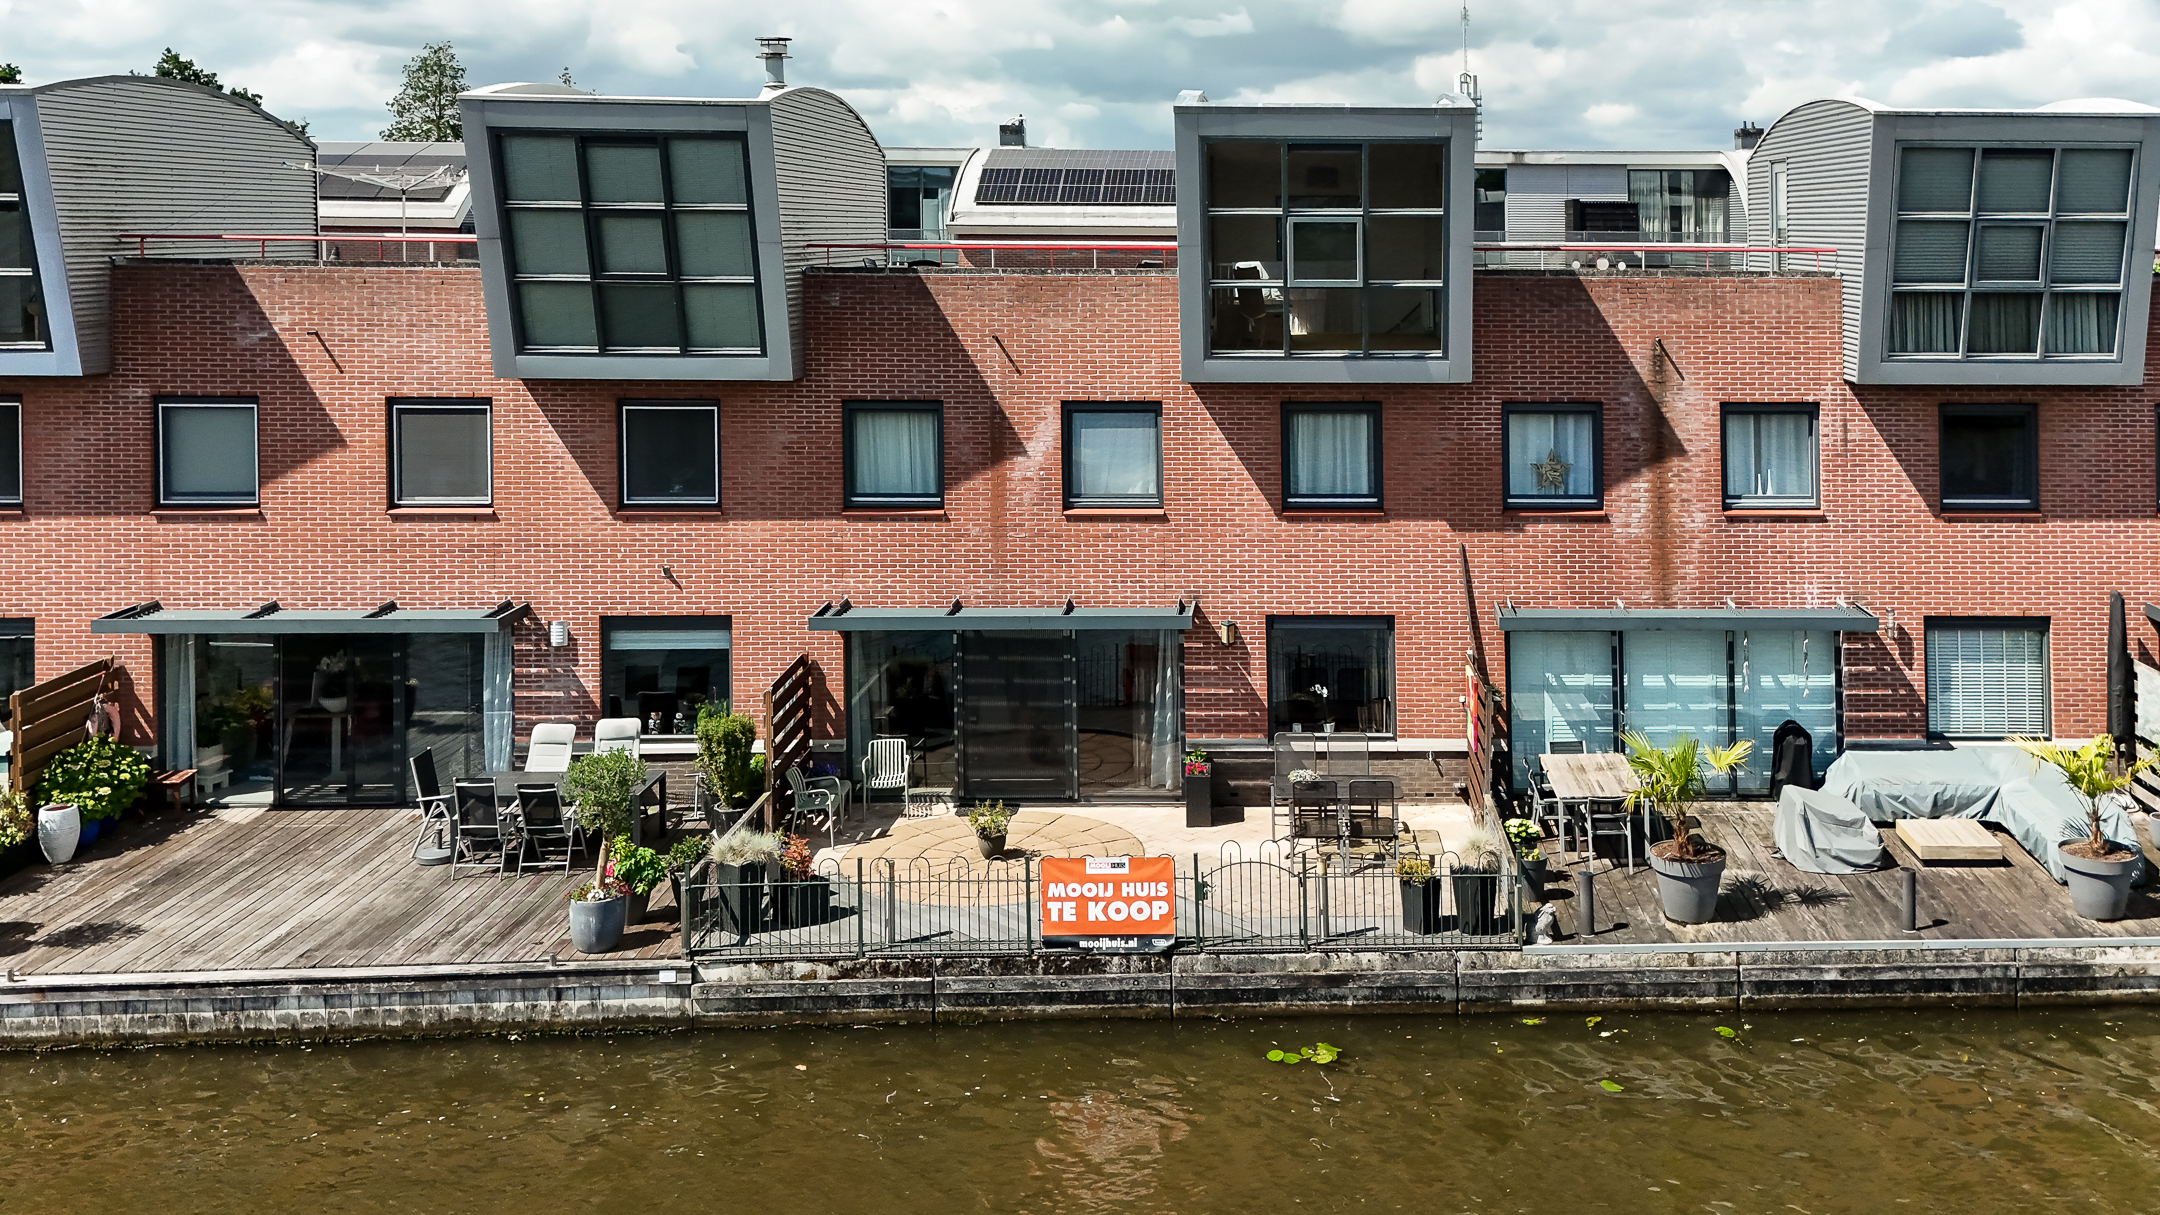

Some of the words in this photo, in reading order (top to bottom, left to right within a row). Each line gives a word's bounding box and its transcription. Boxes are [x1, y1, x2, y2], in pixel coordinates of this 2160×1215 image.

[1047, 882, 1114, 898] MOOIJ
[1121, 881, 1169, 897] HUIS
[1046, 901, 1077, 922] TE
[1087, 900, 1170, 922] KOOP
[1079, 937, 1138, 950] mooijhuis.nl
